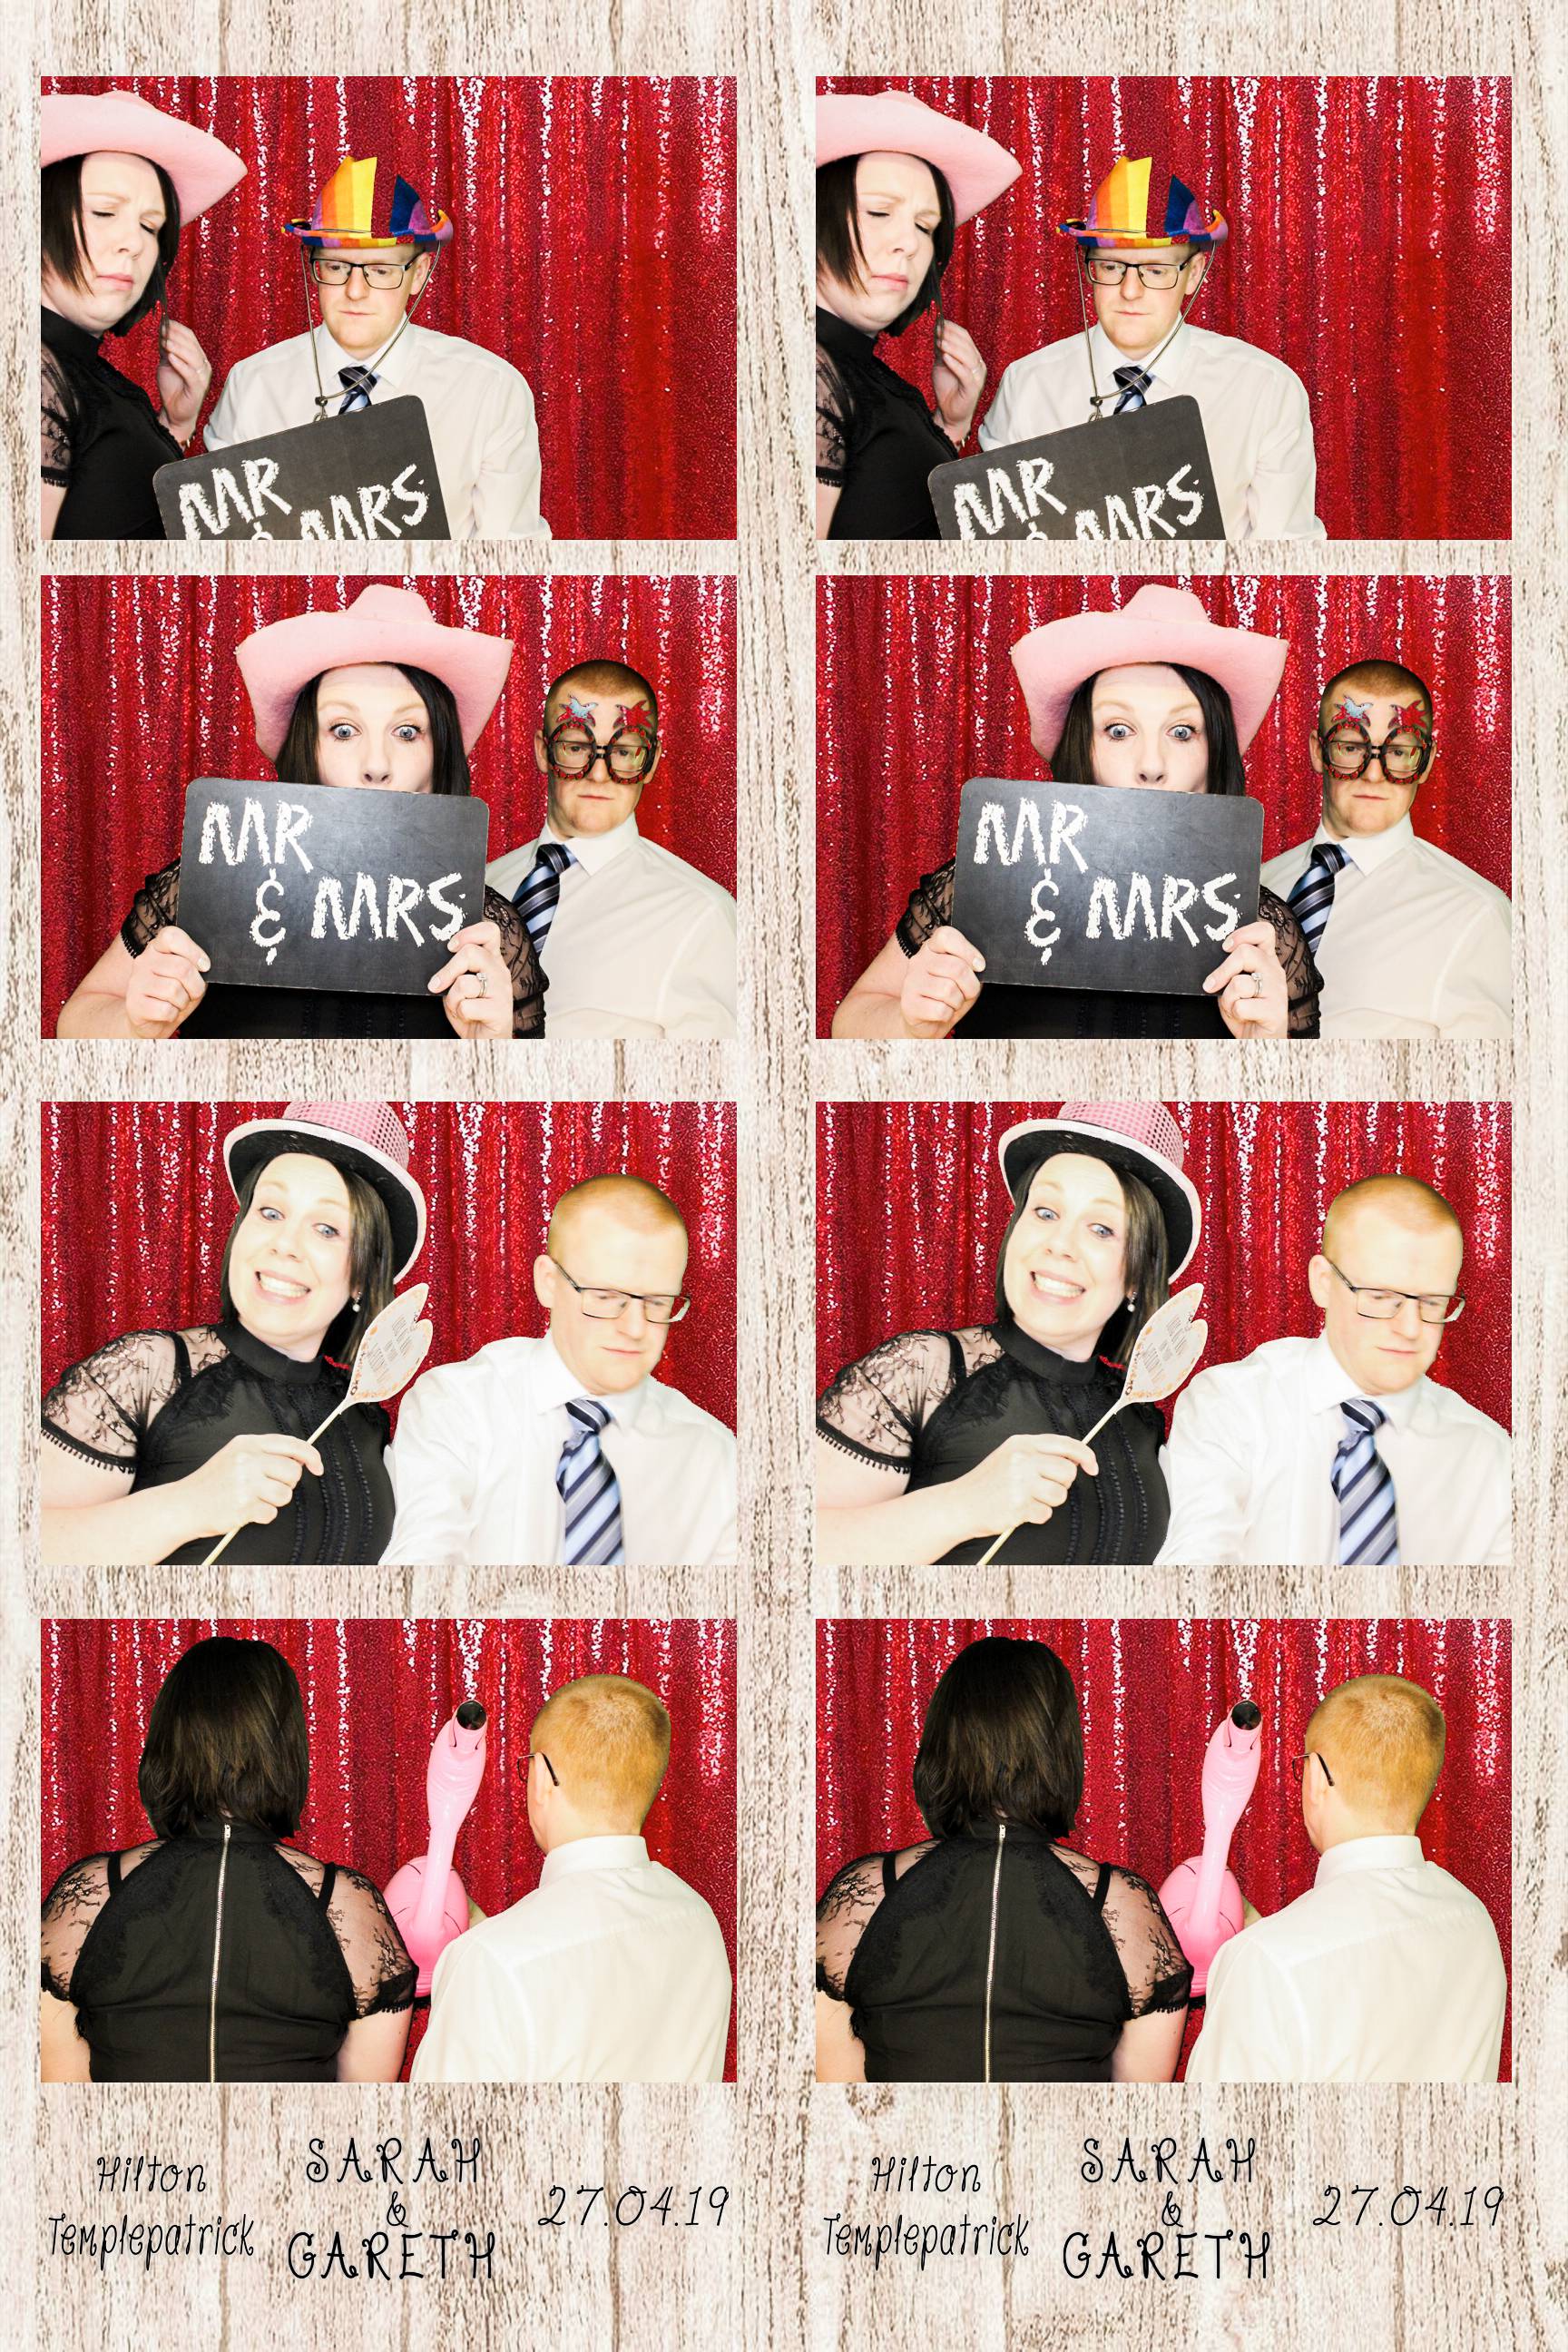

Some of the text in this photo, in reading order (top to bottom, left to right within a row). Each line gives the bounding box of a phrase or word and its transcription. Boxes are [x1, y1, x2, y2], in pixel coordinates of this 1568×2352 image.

[179, 457, 292, 540] MR
[300, 464, 429, 540] MRS
[954, 457, 1067, 540] MR
[1075, 464, 1204, 540] MRS
[198, 797, 314, 874] MR
[973, 797, 1089, 874] MR
[250, 868, 467, 965] & MRS
[1024, 868, 1242, 965] & MRS
